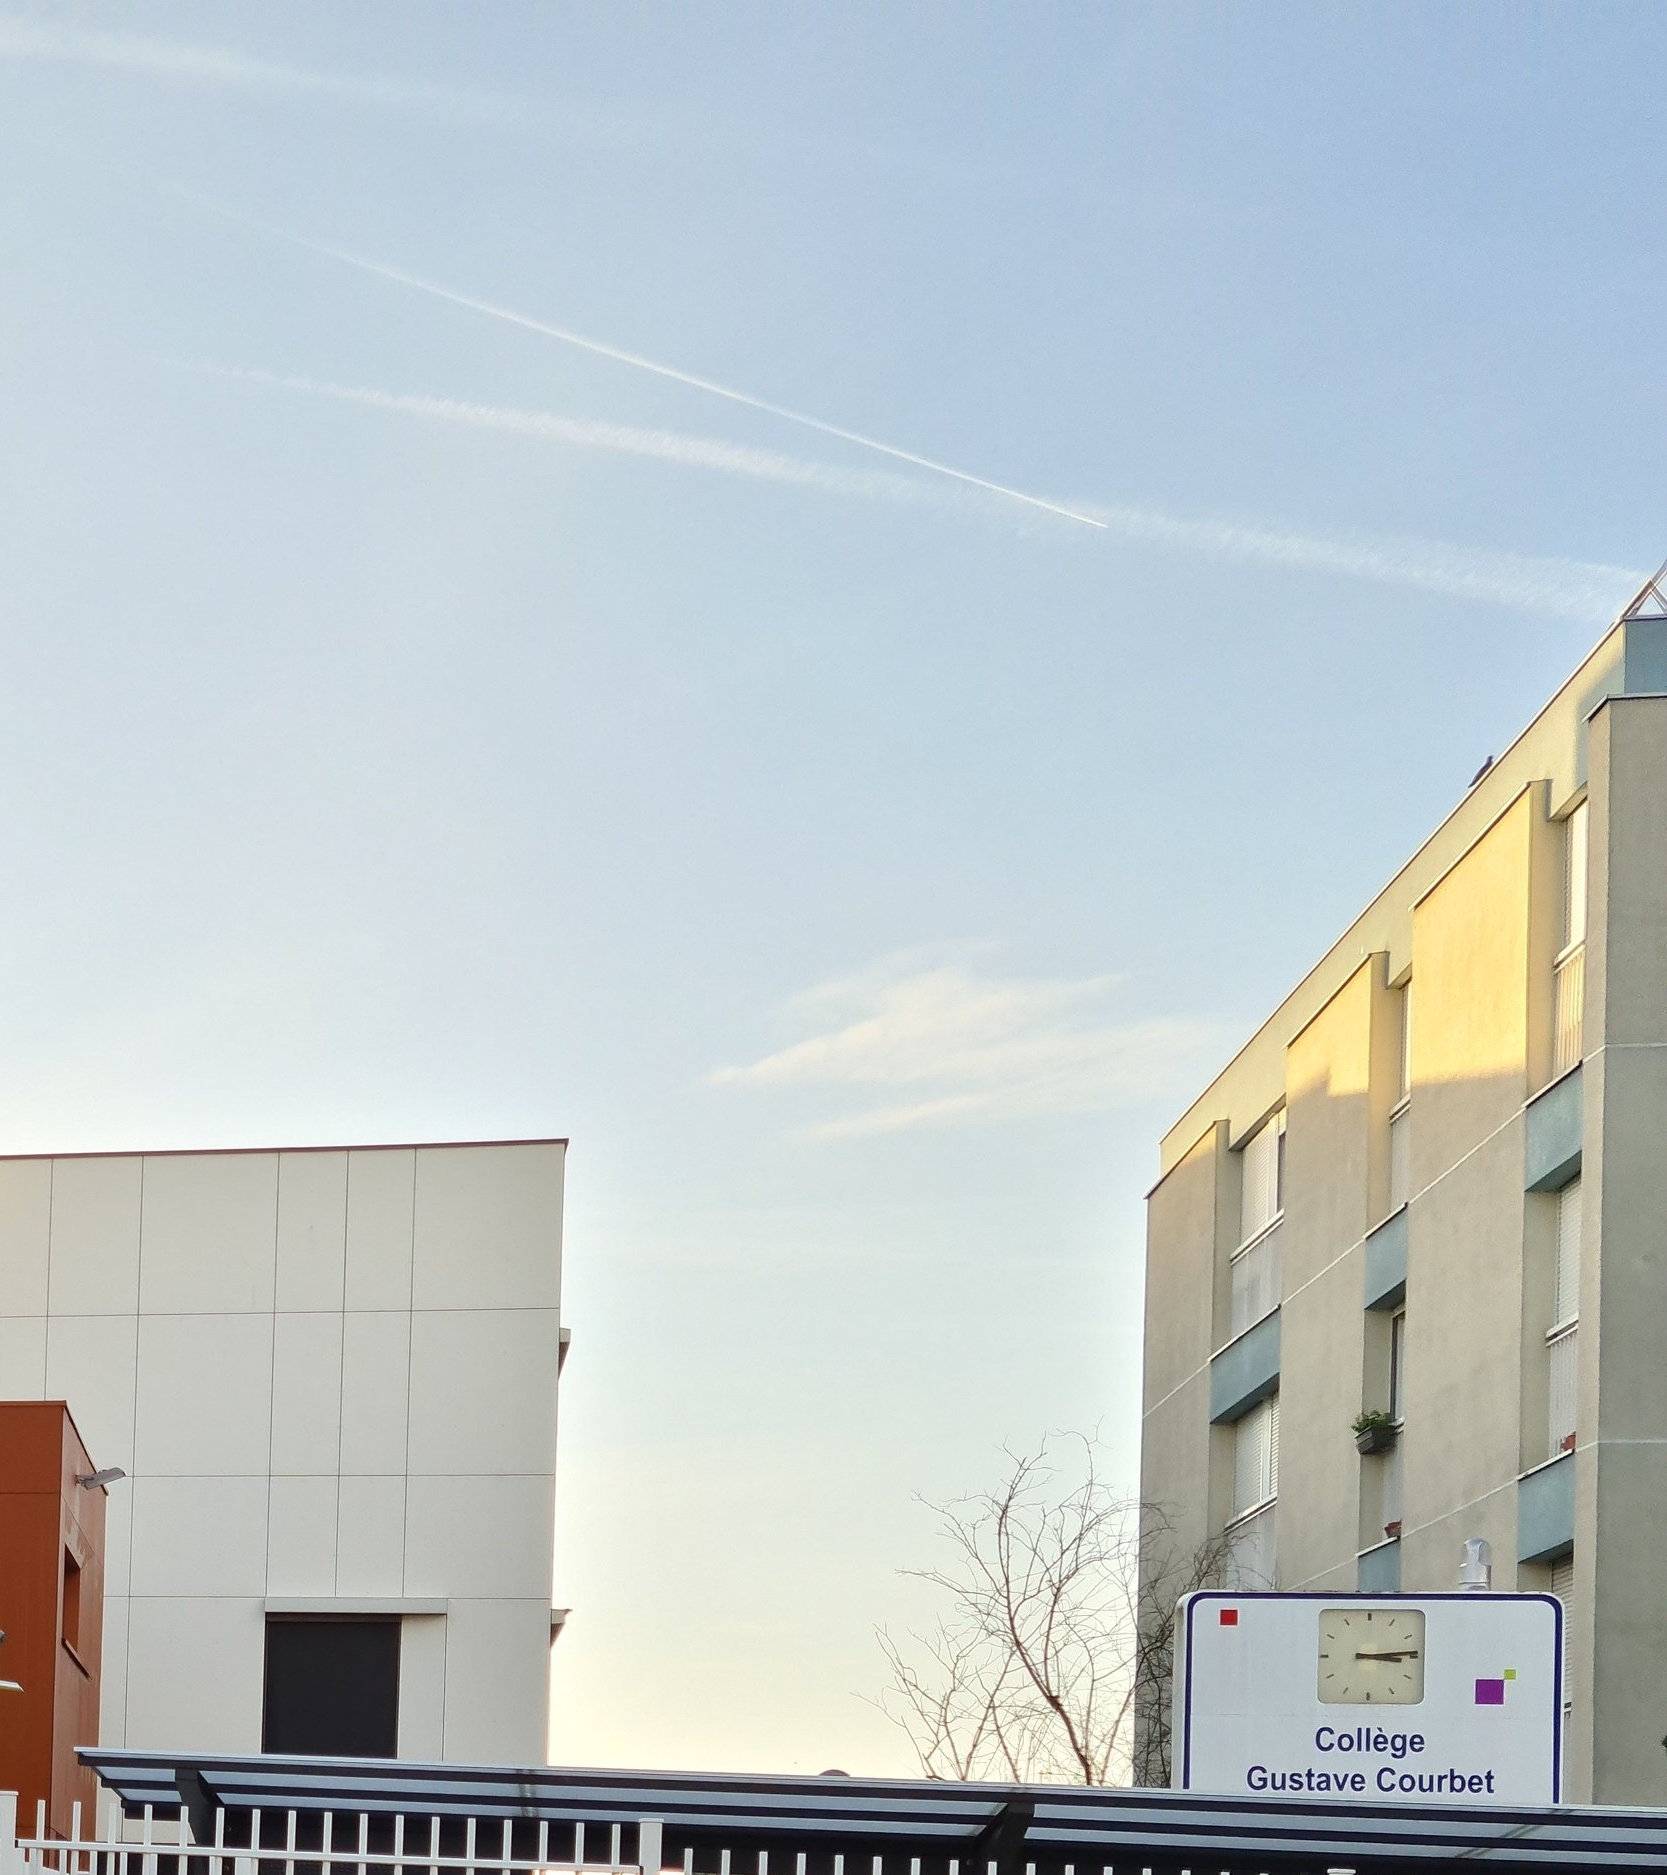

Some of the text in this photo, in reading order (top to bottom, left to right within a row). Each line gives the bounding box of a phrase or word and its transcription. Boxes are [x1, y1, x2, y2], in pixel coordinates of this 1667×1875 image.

[1315, 1726, 1425, 1759] Collège
[1247, 1765, 1495, 1794] Gustave Courbet
